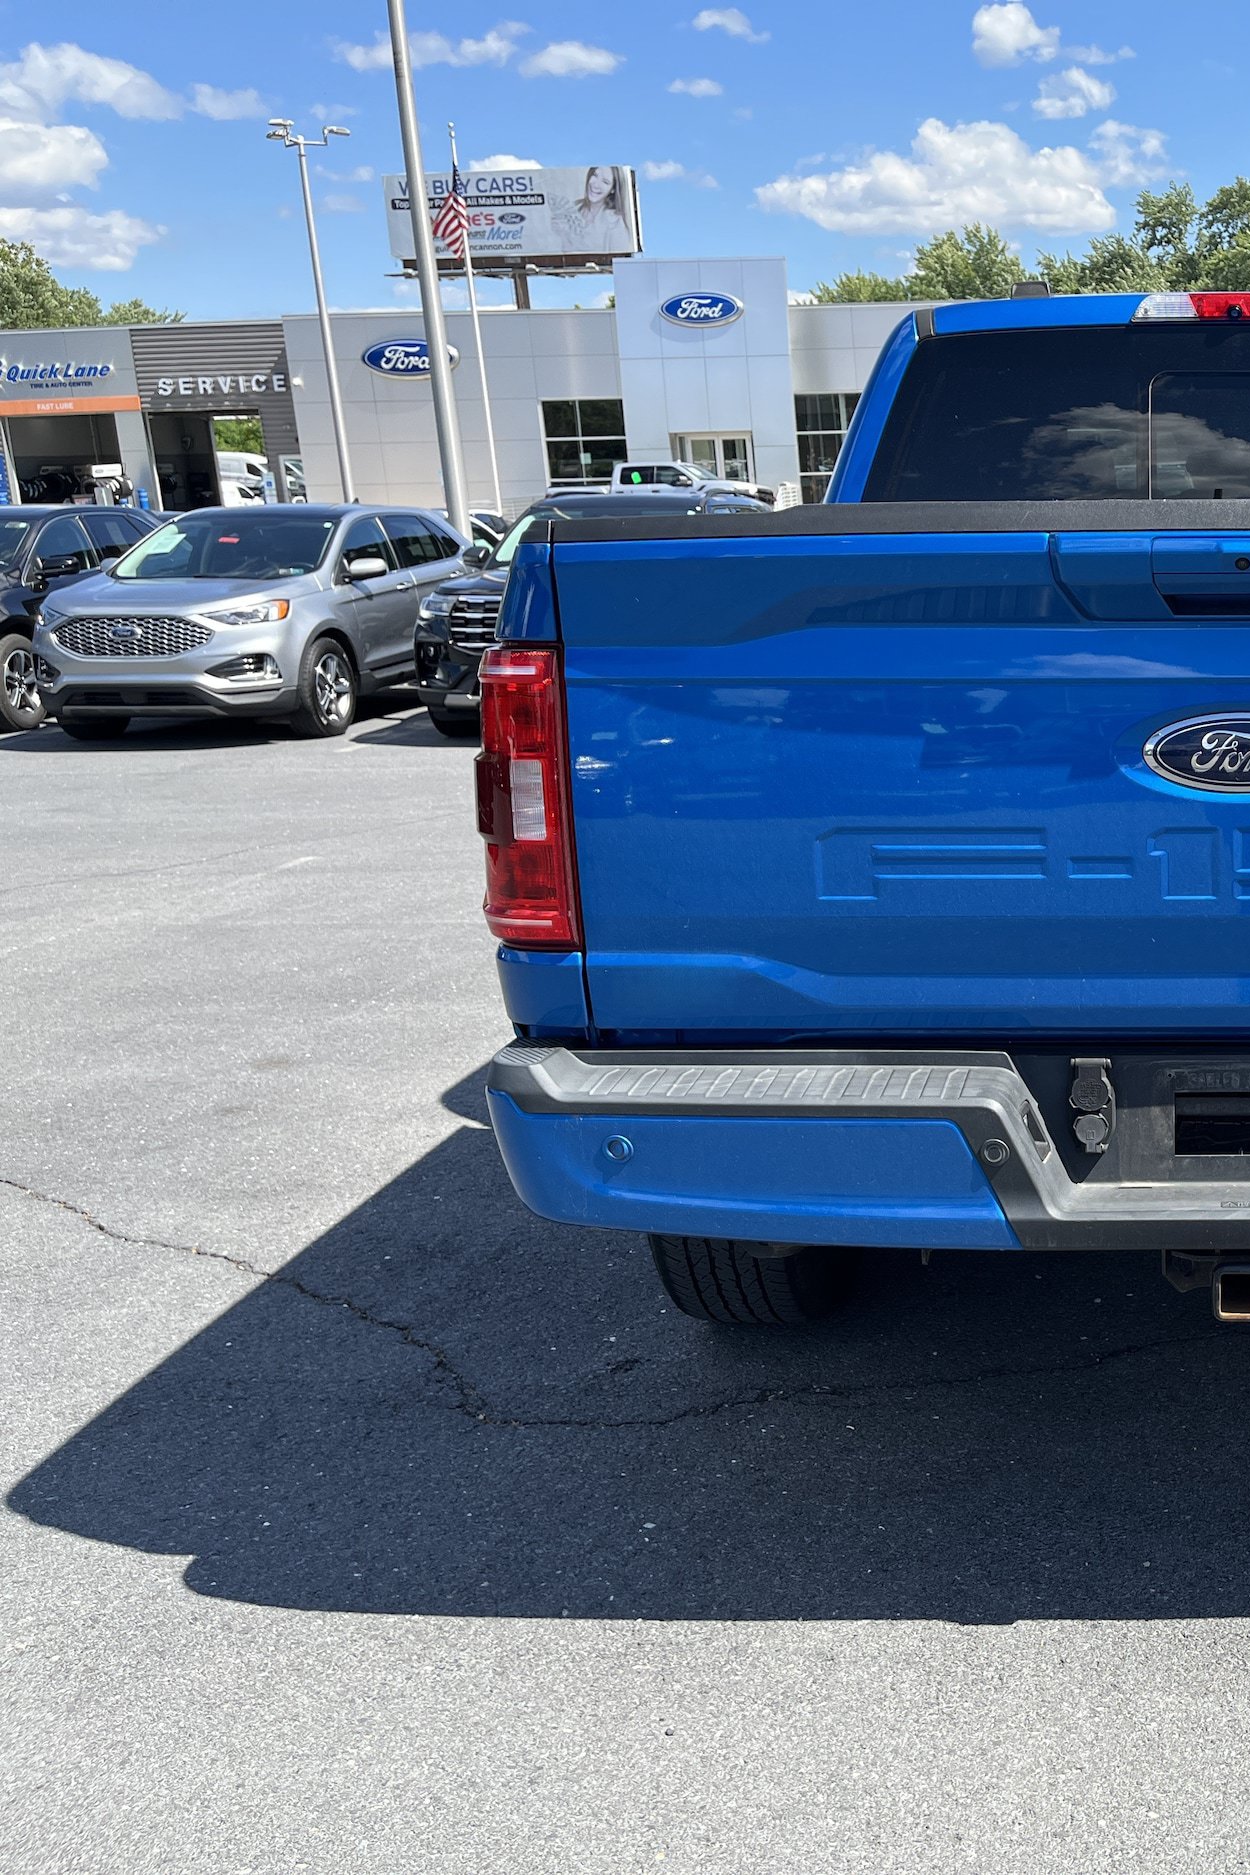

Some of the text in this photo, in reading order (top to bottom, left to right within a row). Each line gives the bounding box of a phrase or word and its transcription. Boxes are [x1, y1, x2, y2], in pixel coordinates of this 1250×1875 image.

[475, 176, 534, 193] CARS!
[395, 194, 543, 209] Top All Makes & Models
[487, 226, 523, 241] More!
[676, 298, 724, 319] Ford
[6, 362, 111, 382] Quick Lane
[157, 374, 287, 397] SERVICE
[55, 402, 74, 410] LUBE
